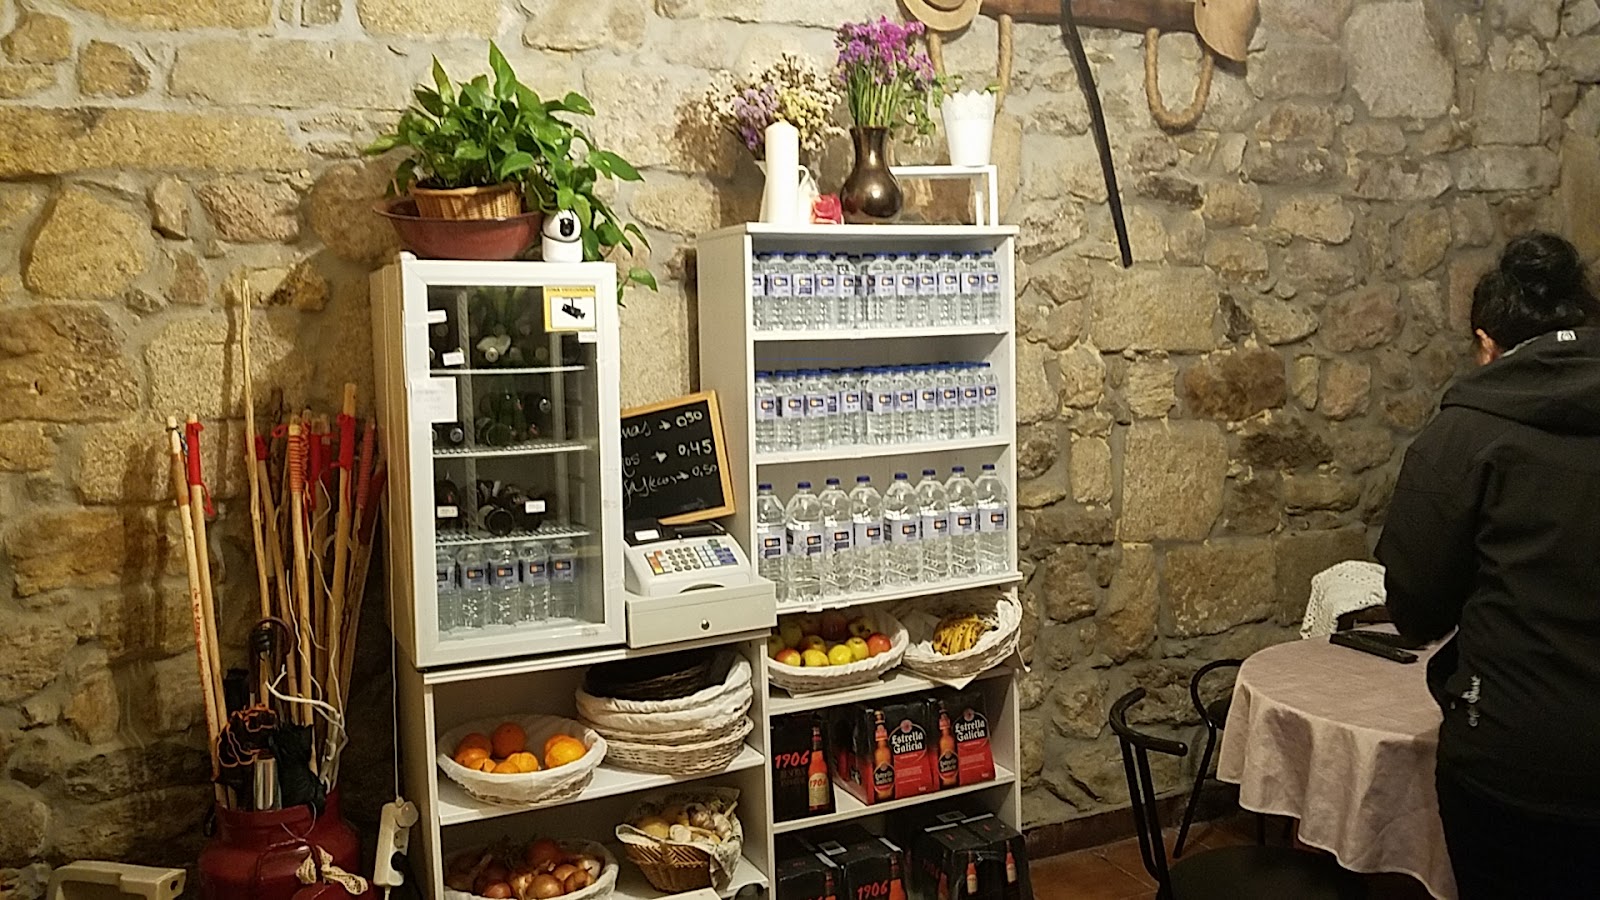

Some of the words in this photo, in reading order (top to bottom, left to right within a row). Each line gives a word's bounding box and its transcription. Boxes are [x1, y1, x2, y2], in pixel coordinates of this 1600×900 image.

[678, 439, 712, 457] 0,45
[954, 719, 985, 733] Estrella
[891, 731, 923, 745] Estrella
[957, 729, 986, 742] Galicia
[893, 742, 923, 754] Galicia
[775, 750, 810, 769] 1906
[857, 880, 889, 900] 1906
